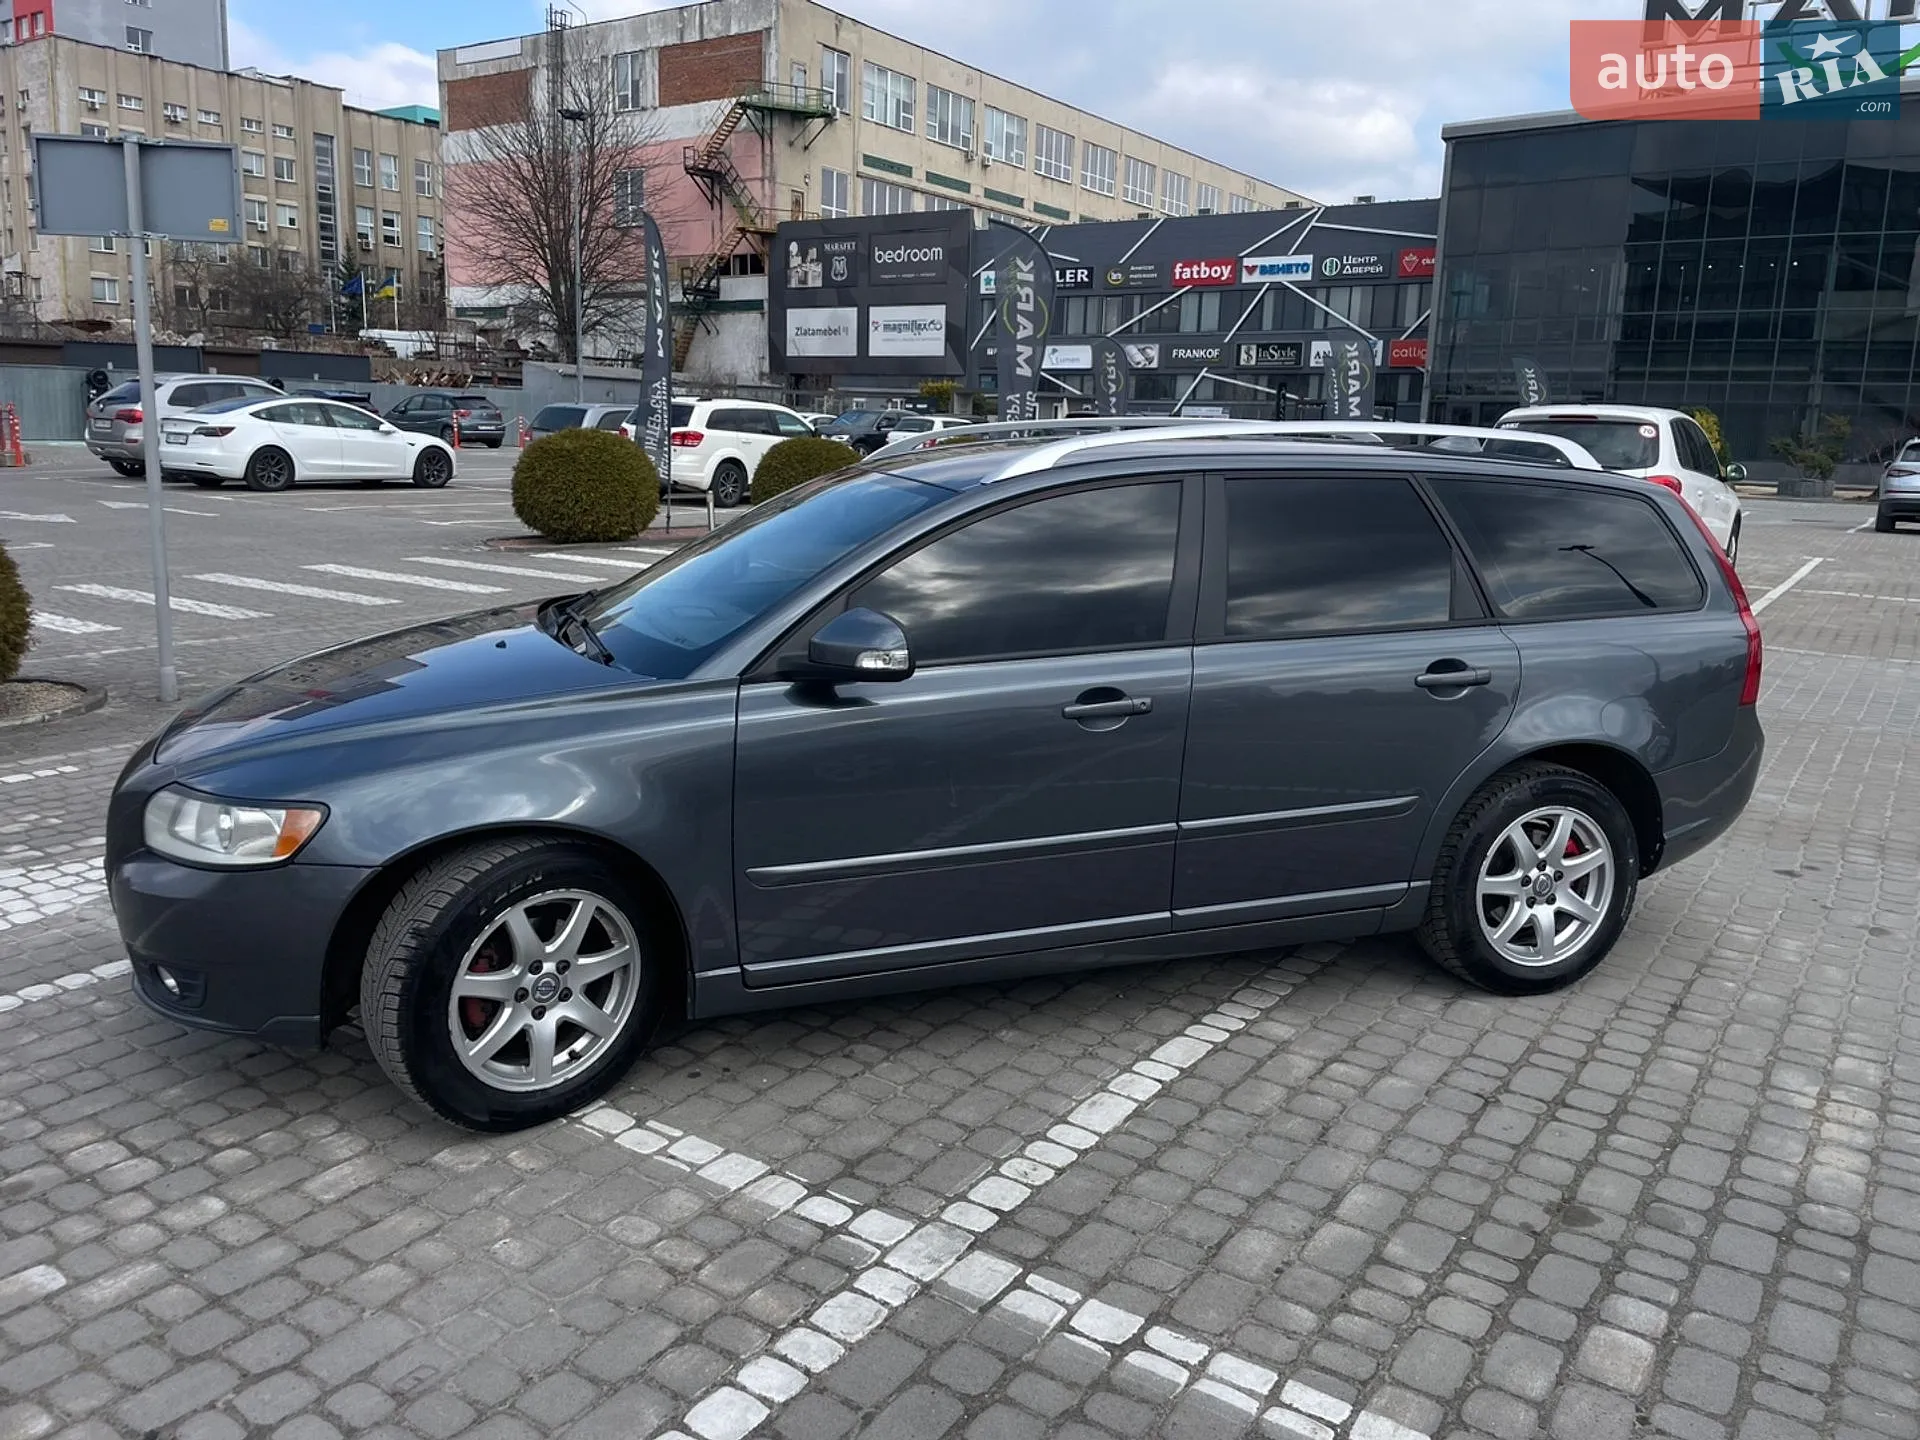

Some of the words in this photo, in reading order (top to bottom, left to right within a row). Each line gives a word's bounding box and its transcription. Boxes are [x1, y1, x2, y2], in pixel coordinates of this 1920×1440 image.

[875, 246, 943, 263] bedroom
[1055, 269, 1089, 283] LER
[1174, 262, 1232, 280] fatboy
[795, 326, 841, 337] Zlatamebel
[1172, 348, 1220, 359] FRANKOF
